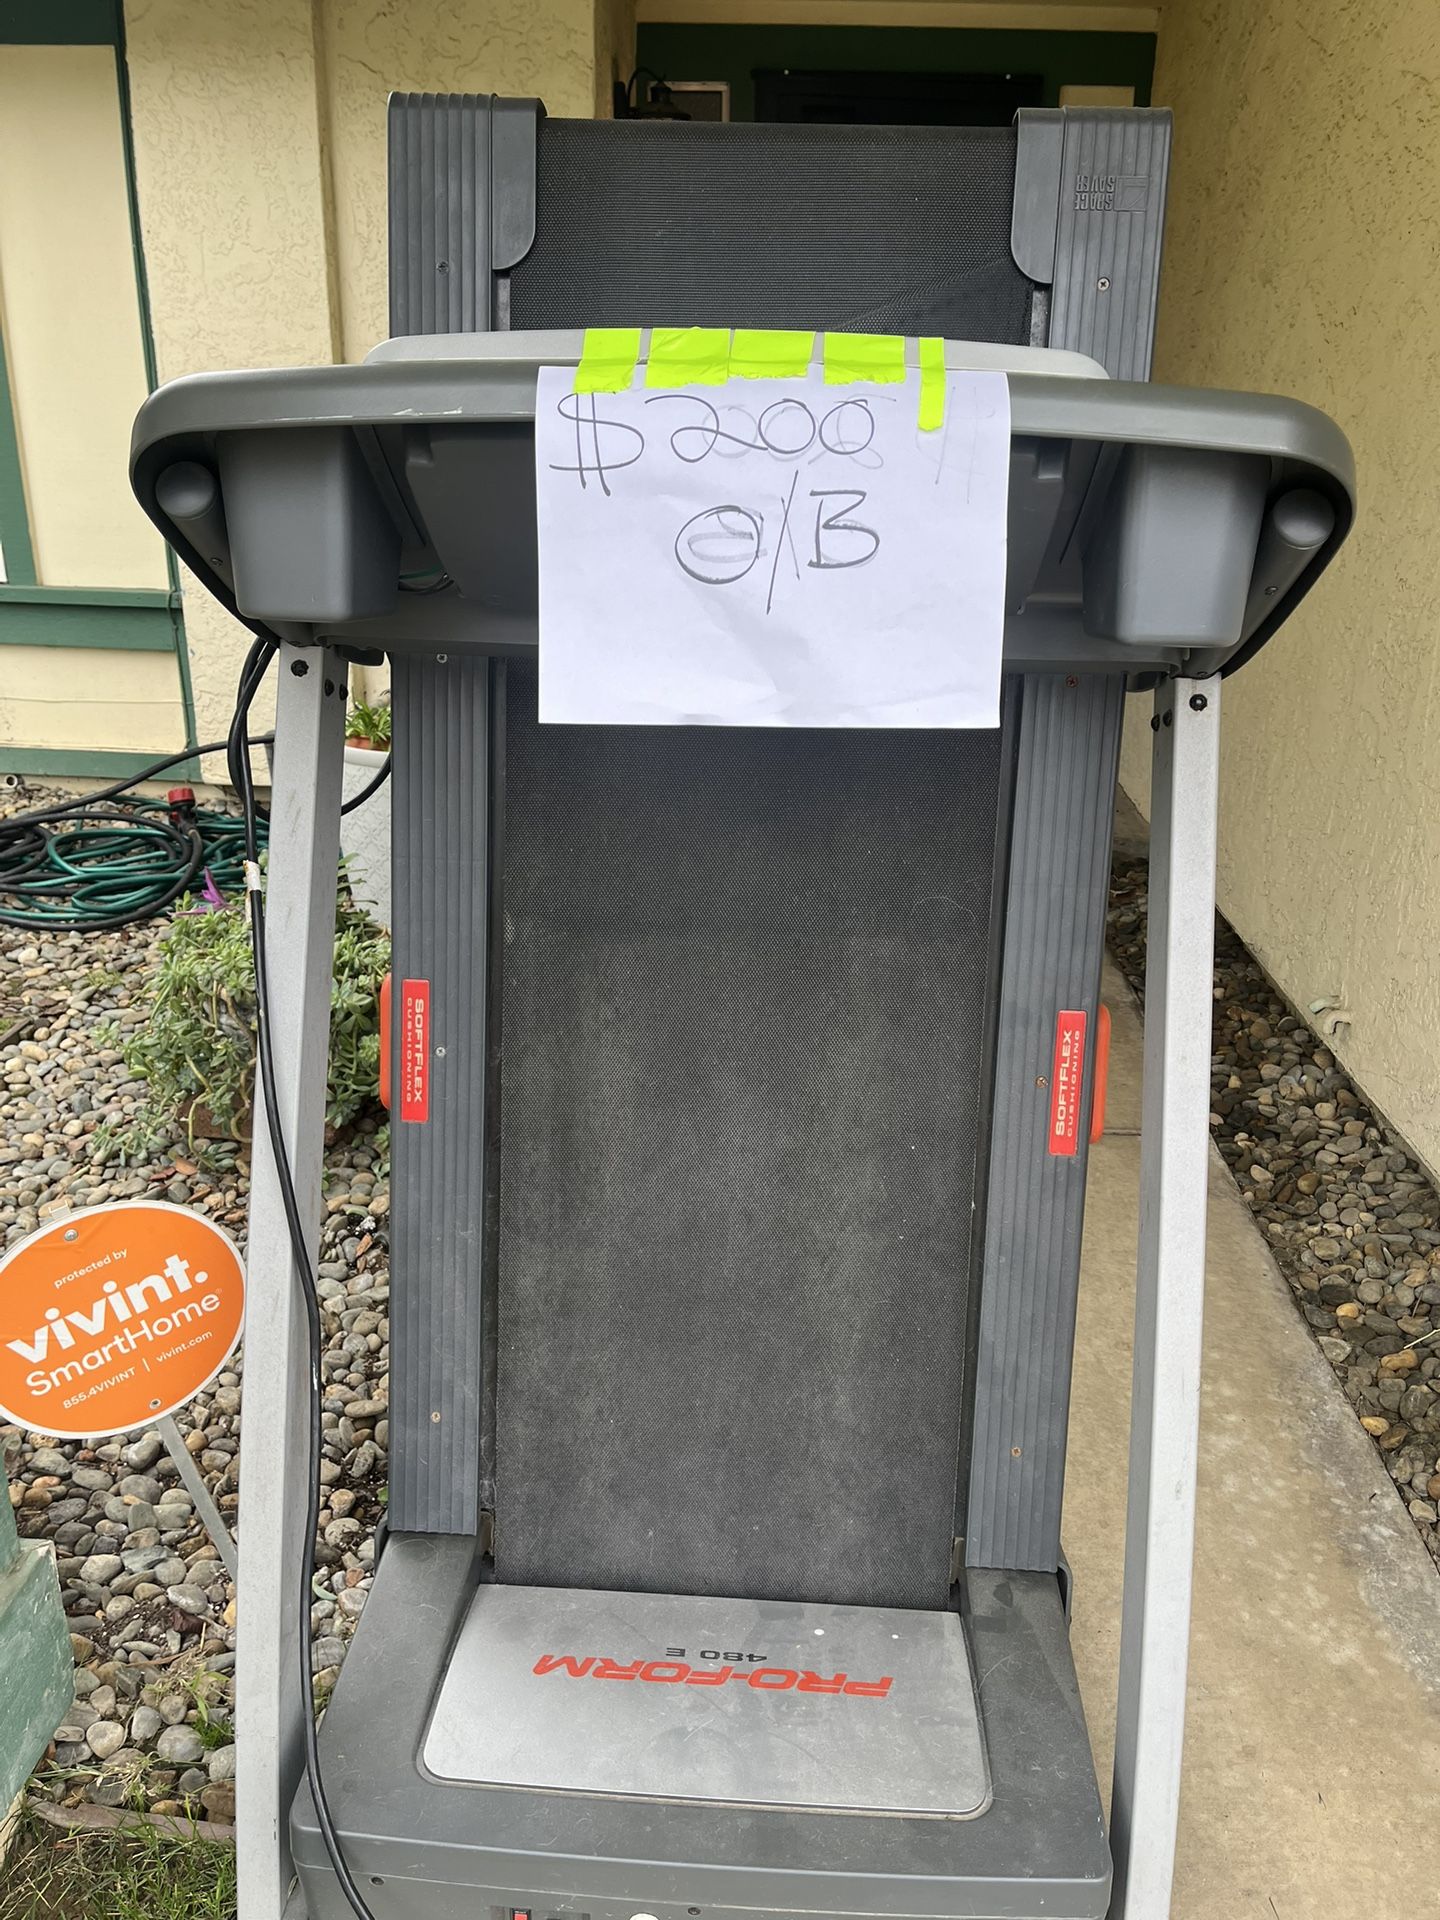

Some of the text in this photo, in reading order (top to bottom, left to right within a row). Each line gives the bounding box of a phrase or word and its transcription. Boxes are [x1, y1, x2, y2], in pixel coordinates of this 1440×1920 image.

[1073, 192, 1113, 211] SPACE
[1076, 175, 1116, 193] SAVER
[1067, 1030, 1080, 1137] CUSHIONING
[54, 1248, 128, 1289] protected by
[26, 1293, 221, 1396] SmartHome
[63, 1367, 137, 1409] 855.4VIVINT
[156, 1330, 213, 1363] vivint.com
[532, 1653, 893, 1697] PRO-FORM
[665, 1647, 767, 1662] 480 E
